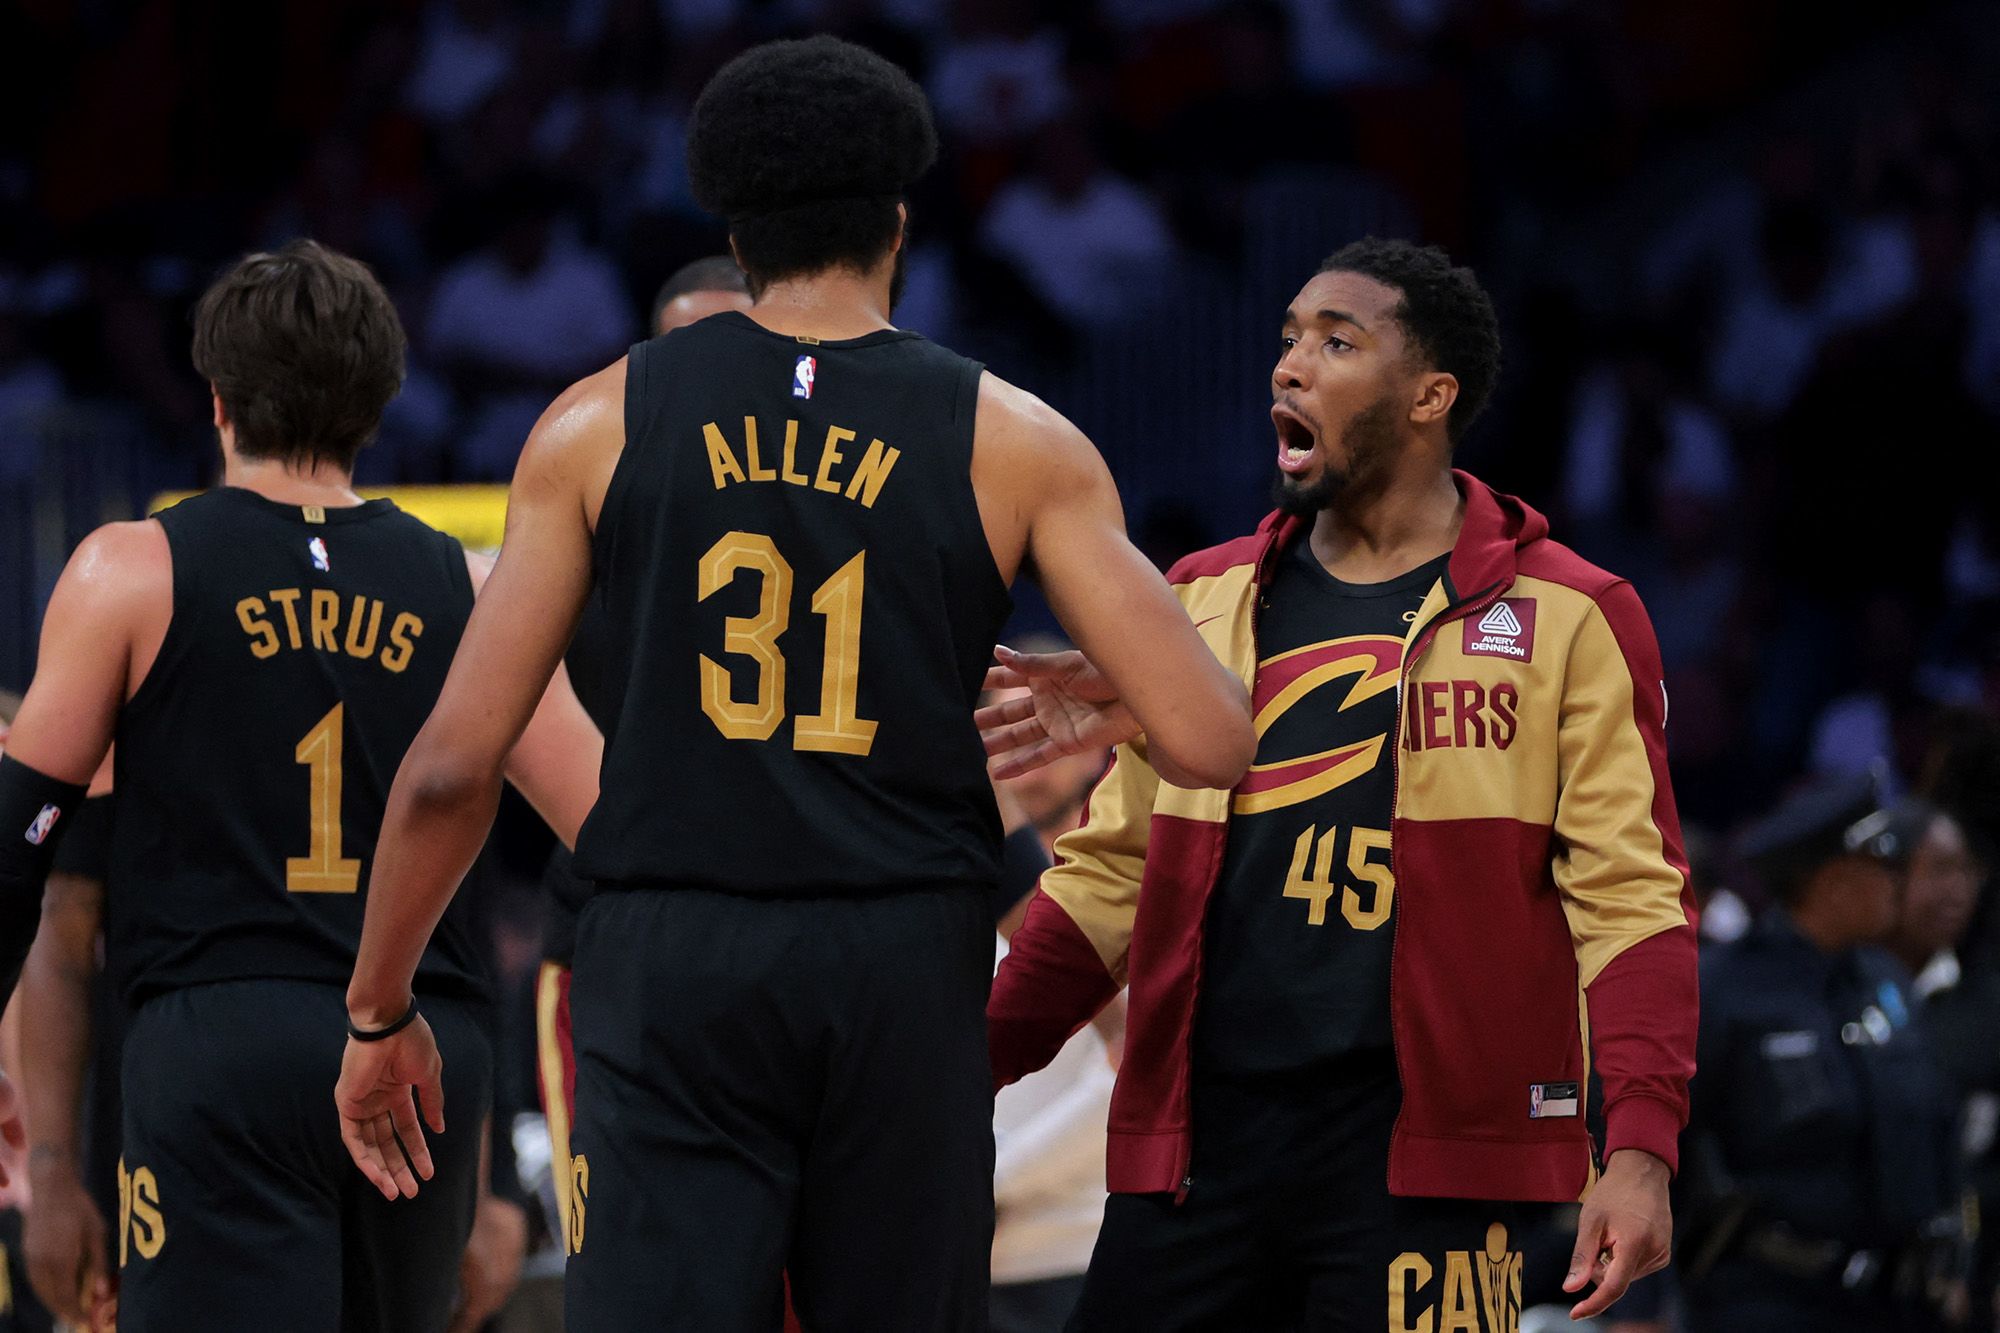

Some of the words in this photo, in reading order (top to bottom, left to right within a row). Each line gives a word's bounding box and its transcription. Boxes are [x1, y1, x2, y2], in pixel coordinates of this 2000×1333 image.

[702, 415, 901, 509] ALLEN
[235, 588, 424, 673] STRUS
[698, 531, 879, 757] 31
[1471, 642, 1525, 657] DENNISON
[1481, 635, 1516, 646] AVERY
[1402, 680, 1519, 752] IERS
[286, 701, 361, 894] 1
[1282, 823, 1396, 931] 45
